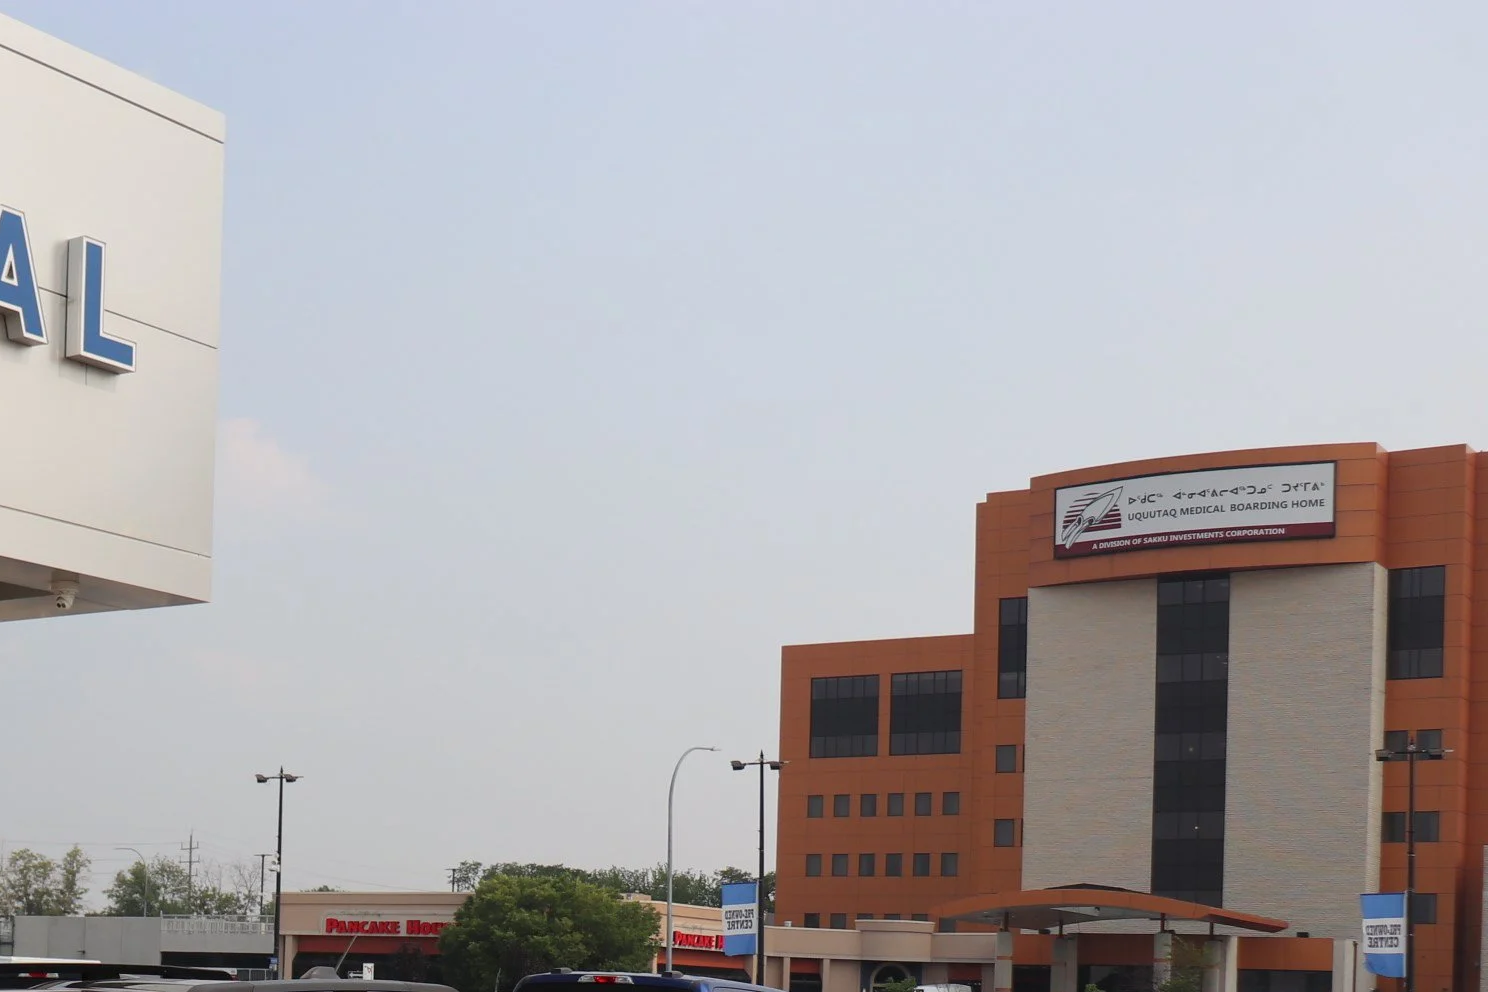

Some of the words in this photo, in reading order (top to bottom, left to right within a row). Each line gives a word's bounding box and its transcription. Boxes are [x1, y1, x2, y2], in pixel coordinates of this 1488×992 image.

[1128, 508, 1178, 522] UQUUTAQ
[1179, 505, 1226, 516] MEDICAL
[1230, 500, 1288, 512] BOARDING
[1291, 498, 1325, 508] HOME
[1098, 539, 1130, 549] DIVISION
[1143, 535, 1168, 544] SAKKU
[1169, 531, 1224, 542] INVESTMENTS
[1225, 528, 1285, 538] CORPORATION
[325, 918, 401, 934] PANCAKE
[673, 930, 715, 949] PANCAKE
